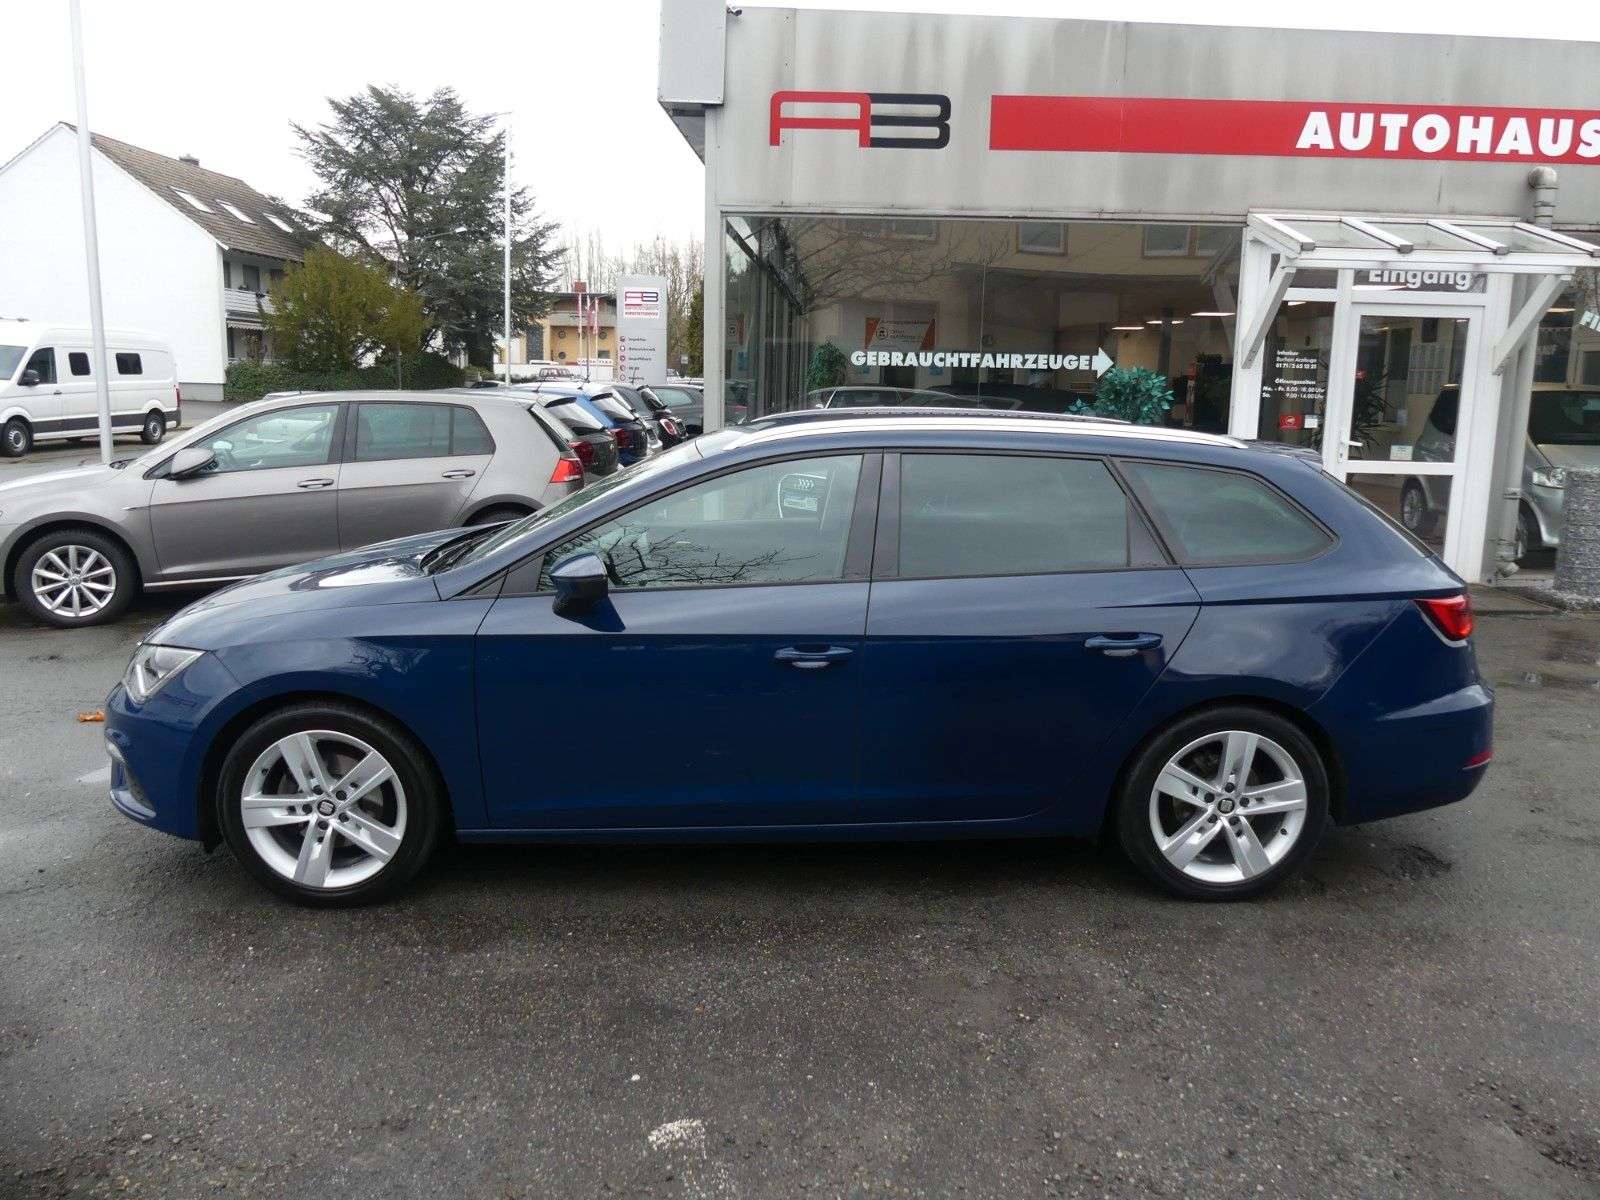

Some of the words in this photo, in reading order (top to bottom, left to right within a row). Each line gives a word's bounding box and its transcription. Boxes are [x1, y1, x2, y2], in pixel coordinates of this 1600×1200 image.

[1296, 111, 1600, 158] AUTOHAUS
[1369, 269, 1472, 291] Eingang
[850, 350, 1093, 370] GEBRAUCHTFAHRZEUGE
